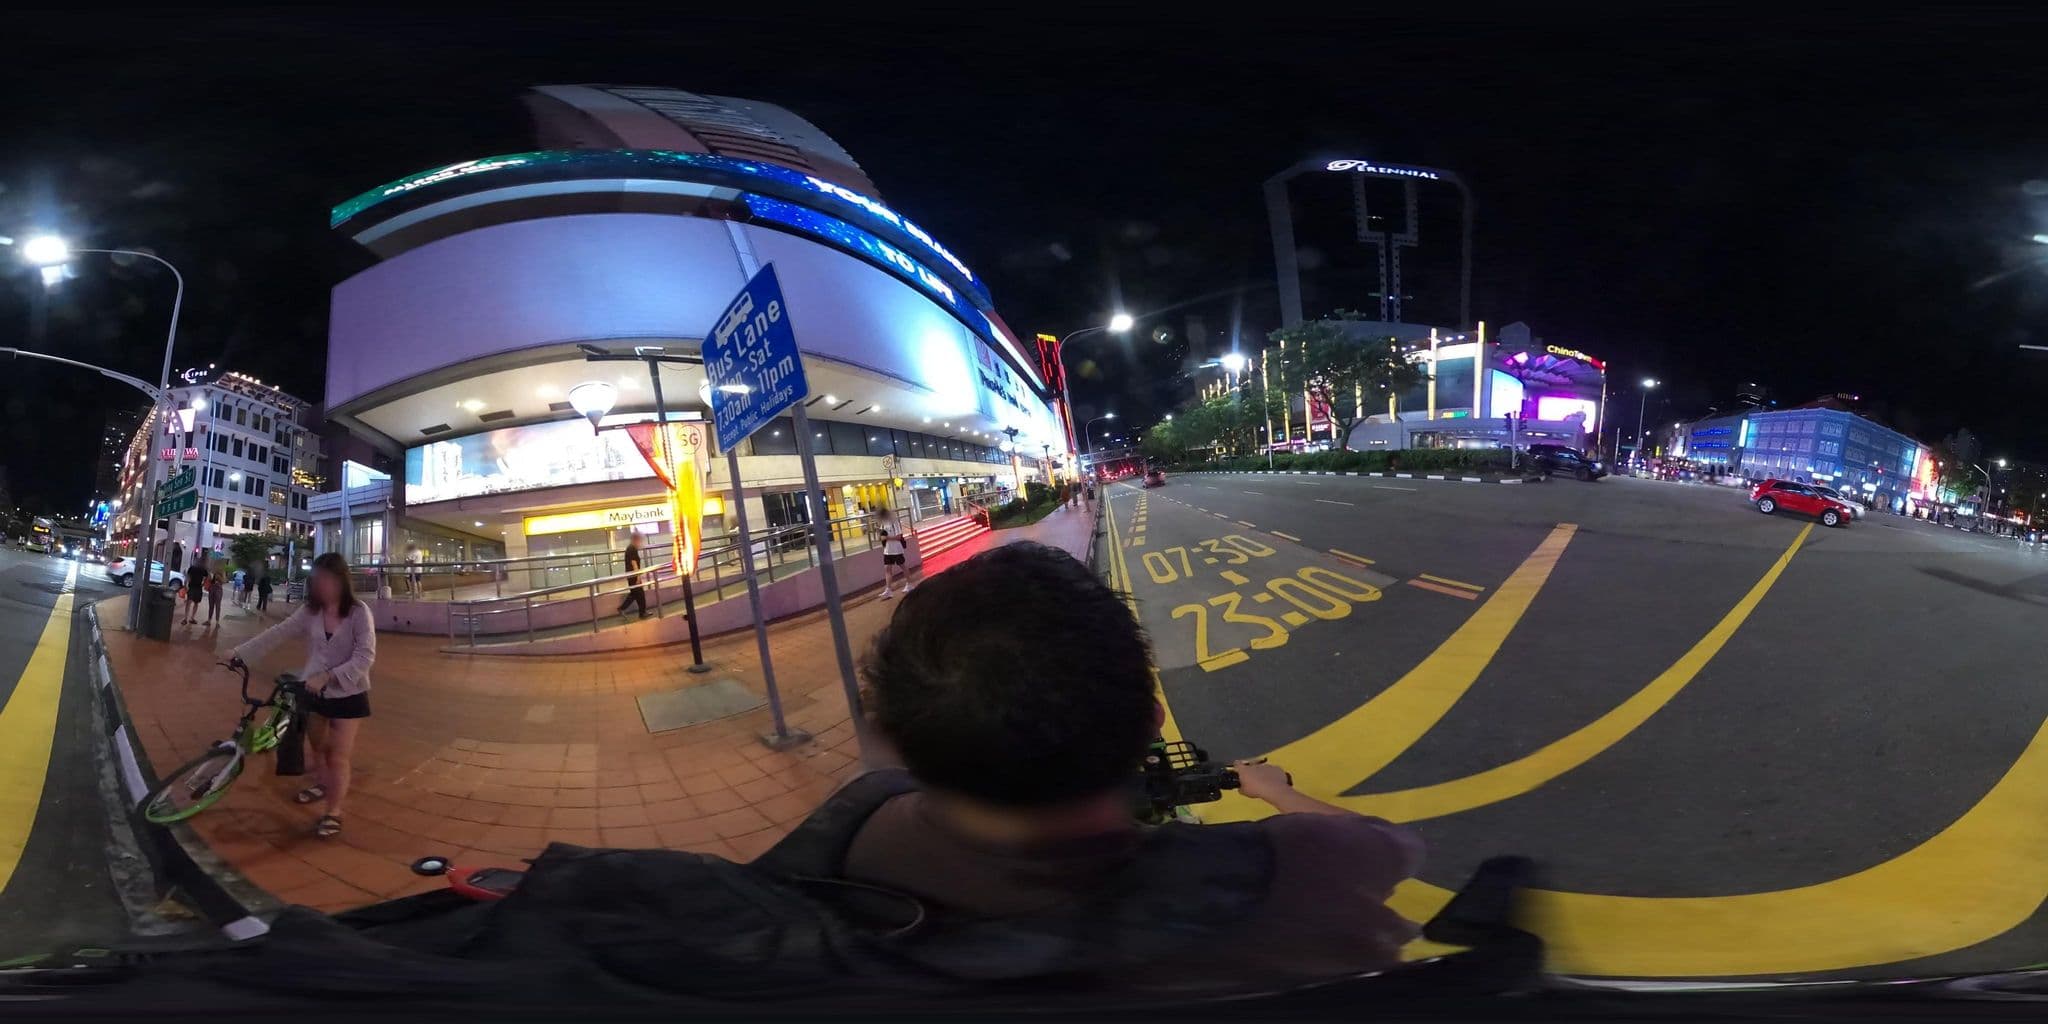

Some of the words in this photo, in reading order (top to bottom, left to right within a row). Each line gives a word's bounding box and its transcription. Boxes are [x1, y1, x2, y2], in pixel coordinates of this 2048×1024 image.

[707, 349, 734, 386] Bus
[734, 300, 781, 357] Lane
[757, 355, 794, 394] 11pm
[722, 421, 739, 445] Except
[740, 411, 759, 431] Public
[760, 385, 794, 415] Holidays
[609, 507, 665, 522] Maybank
[1142, 535, 1276, 584] 07:30
[1171, 567, 1383, 673] 23:00
